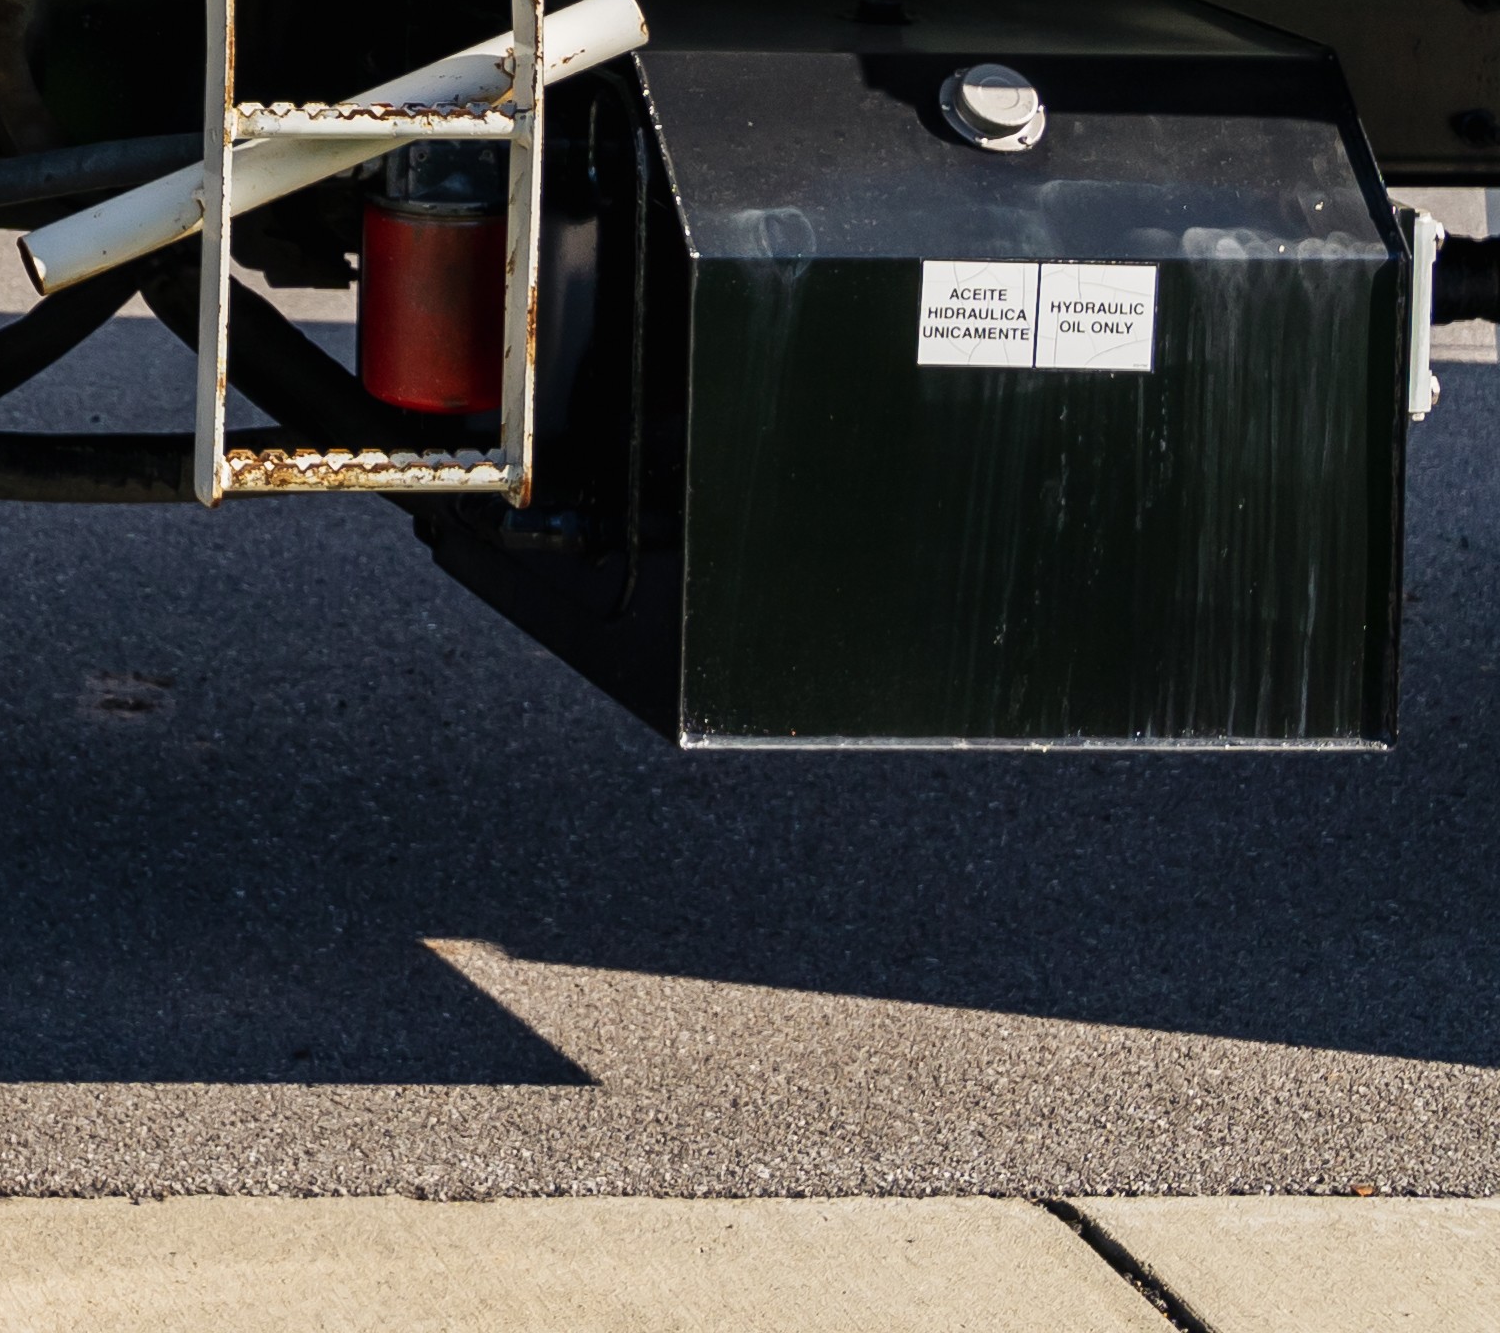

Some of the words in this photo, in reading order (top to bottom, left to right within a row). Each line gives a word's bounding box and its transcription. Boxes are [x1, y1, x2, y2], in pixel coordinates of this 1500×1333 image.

[948, 287, 1008, 302] ACEITE
[926, 305, 1028, 322] HIDRAULICA
[1049, 300, 1146, 316] HYDRAULIC
[922, 324, 1031, 341] UNICAMENTE
[1059, 319, 1086, 334] OIL
[1090, 320, 1135, 335] ONLY
